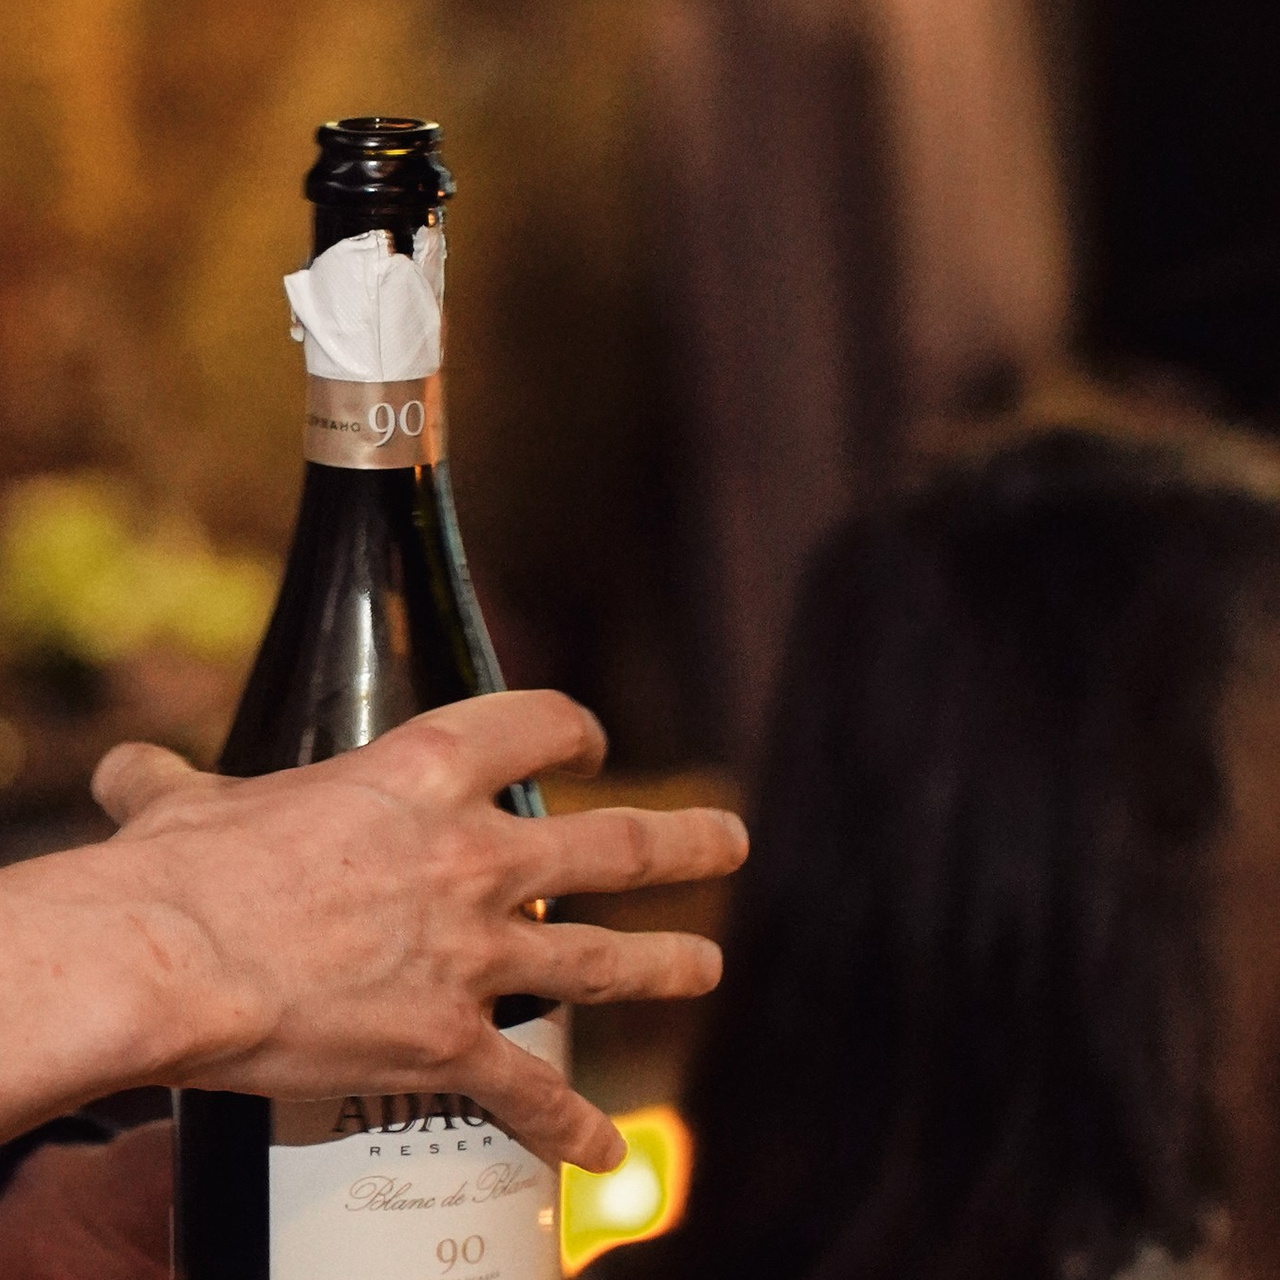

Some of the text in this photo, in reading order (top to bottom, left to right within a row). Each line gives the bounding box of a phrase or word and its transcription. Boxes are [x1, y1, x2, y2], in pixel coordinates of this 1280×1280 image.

[368, 400, 426, 447] 90
[369, 1133, 516, 1157] RESER
[344, 1174, 436, 1211] Blanc
[440, 1181, 467, 1208] de
[436, 1234, 486, 1275] 90
